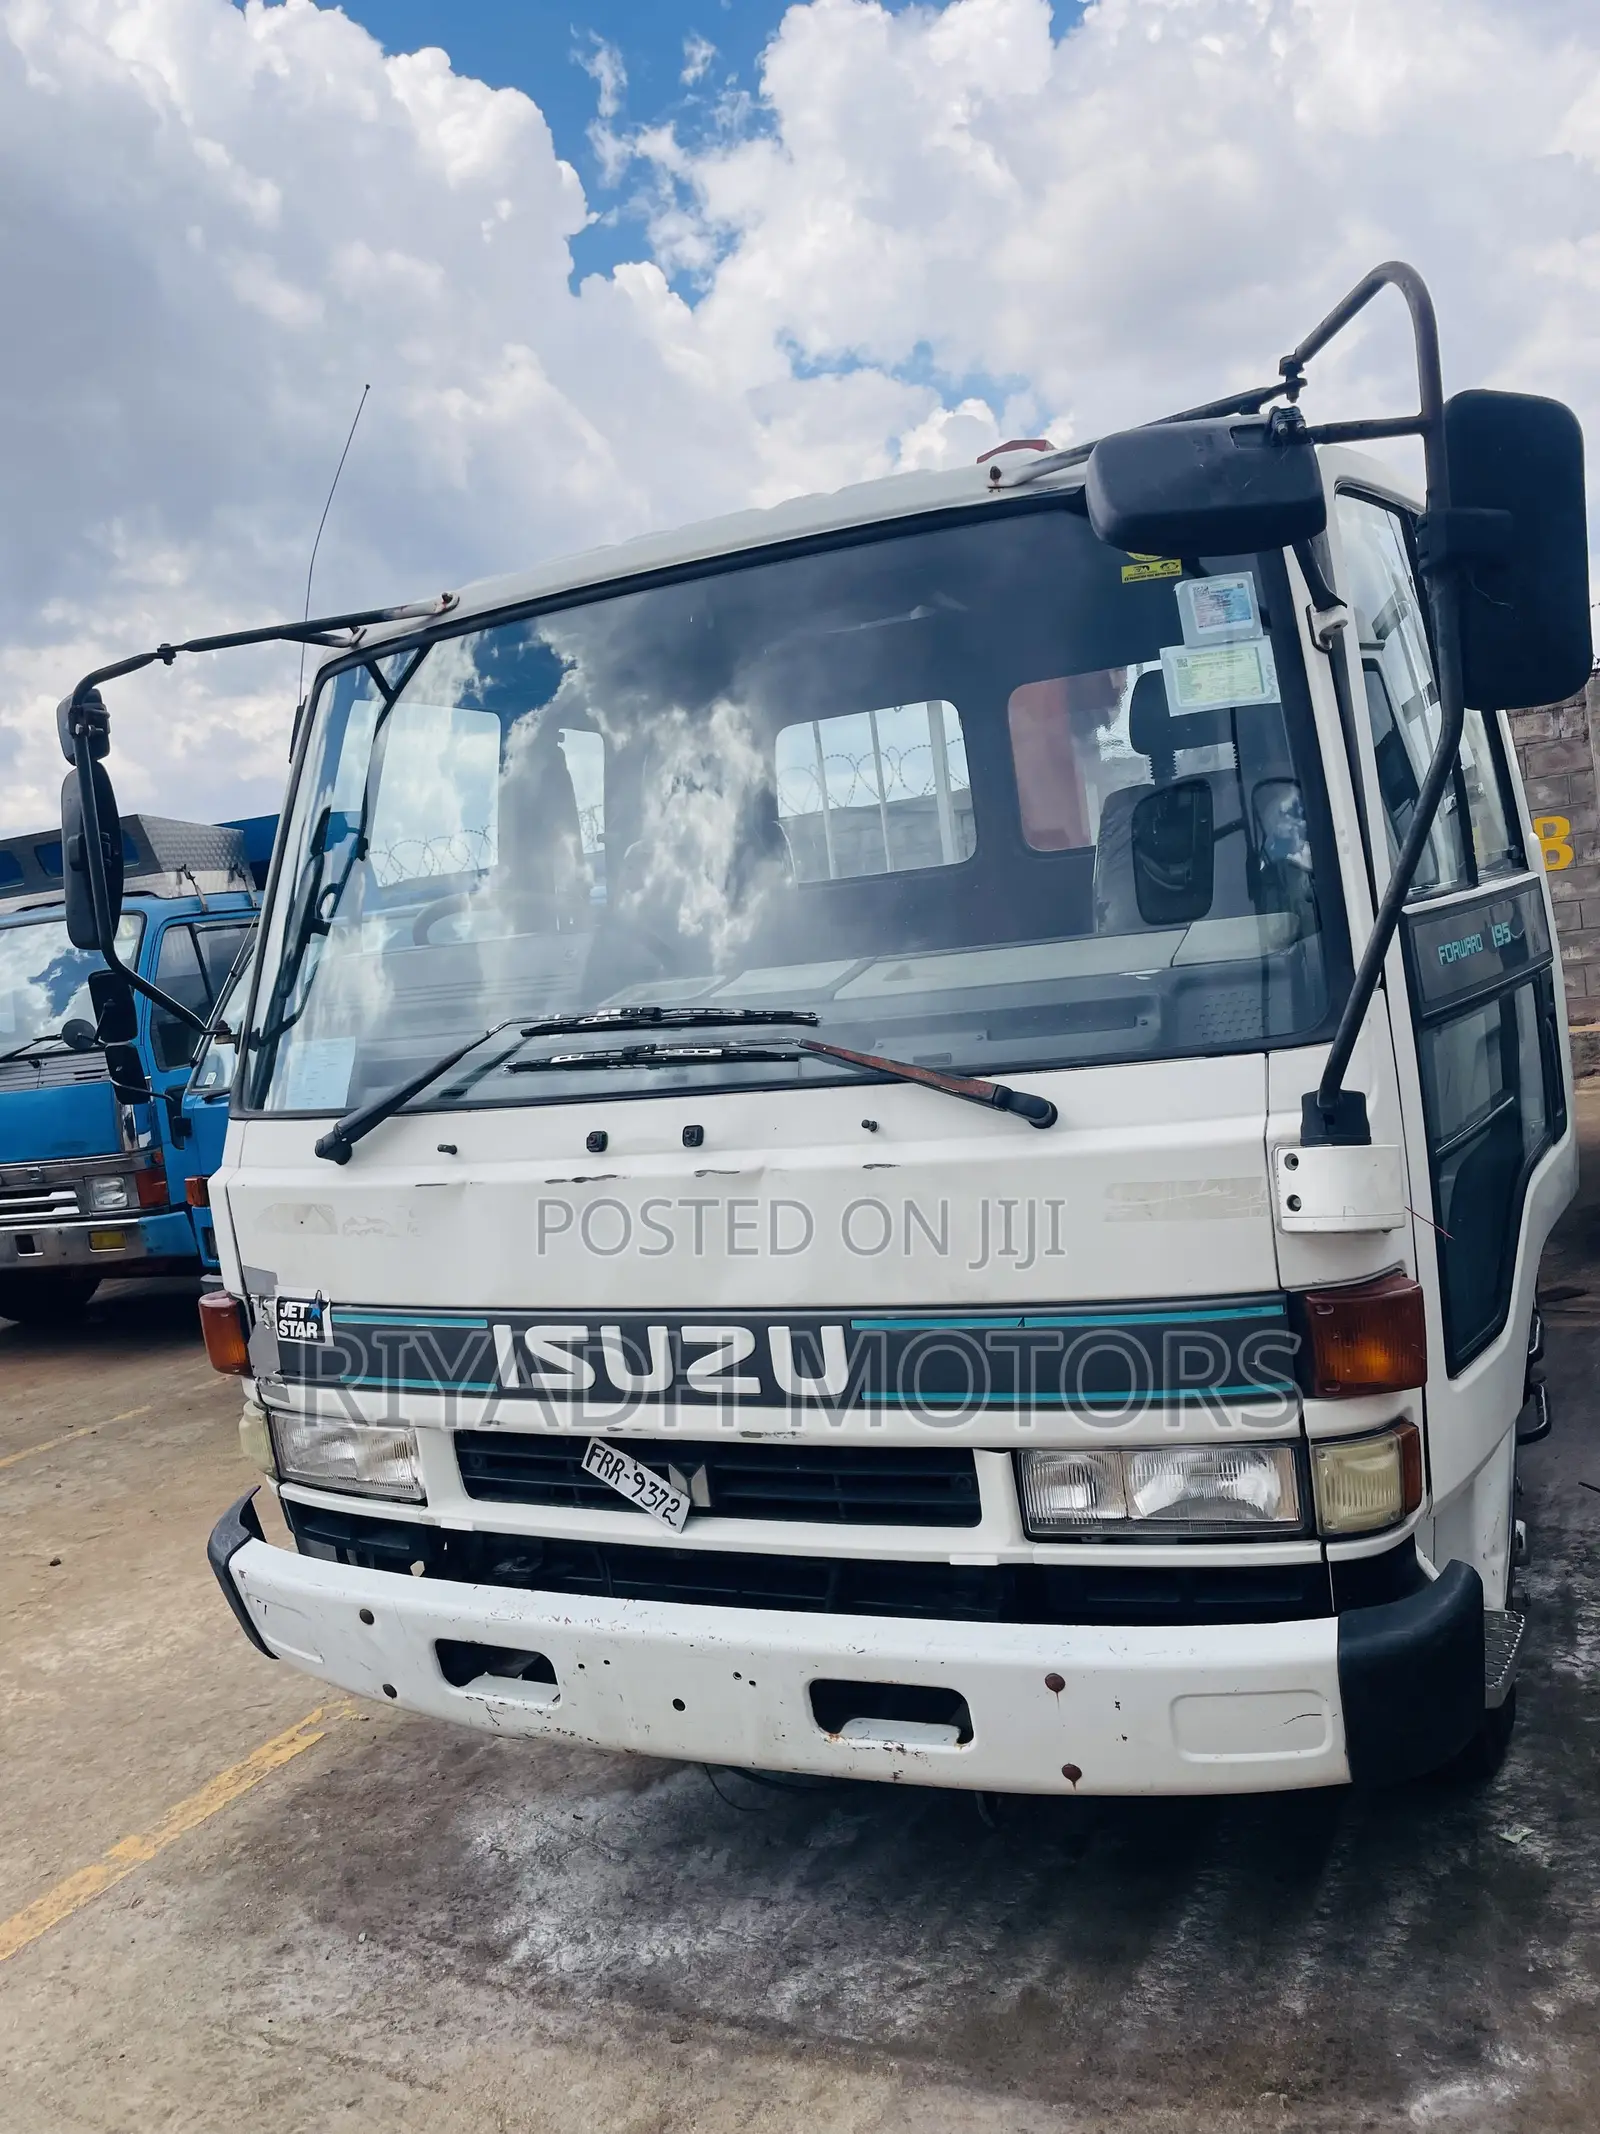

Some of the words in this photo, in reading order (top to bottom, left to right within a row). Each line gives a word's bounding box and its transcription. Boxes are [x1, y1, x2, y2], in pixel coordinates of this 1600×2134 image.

[1438, 933, 1483, 966] FORWARD
[280, 1301, 310, 1318] JET
[279, 1320, 318, 1339] STAR
[493, 1324, 850, 1398] ISUZU
[585, 1443, 681, 1527] FRR-9372
